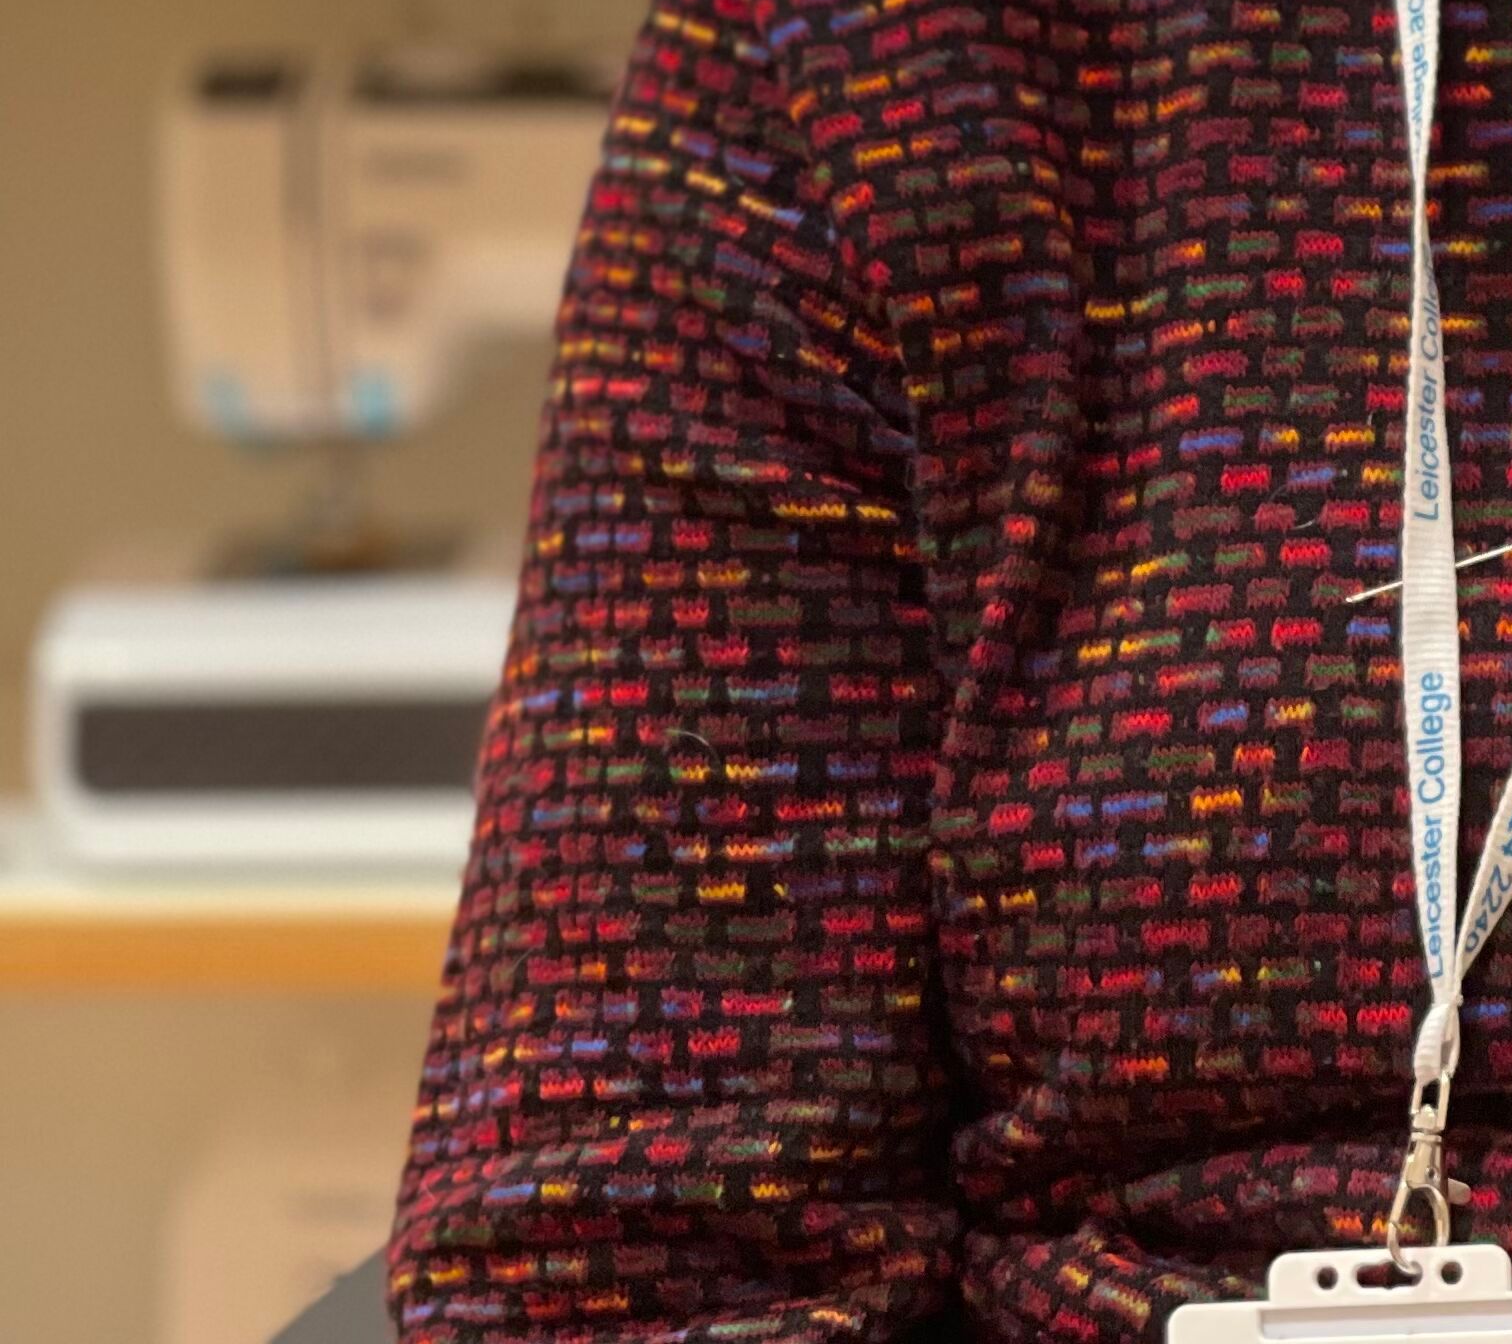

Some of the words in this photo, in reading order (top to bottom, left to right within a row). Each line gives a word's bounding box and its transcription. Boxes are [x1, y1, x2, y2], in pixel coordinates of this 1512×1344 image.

[1413, 375, 1440, 522] Leicester
[1415, 671, 1451, 804] College
[1420, 815, 1444, 978] Leicester
[1464, 867, 1512, 953] 2240
